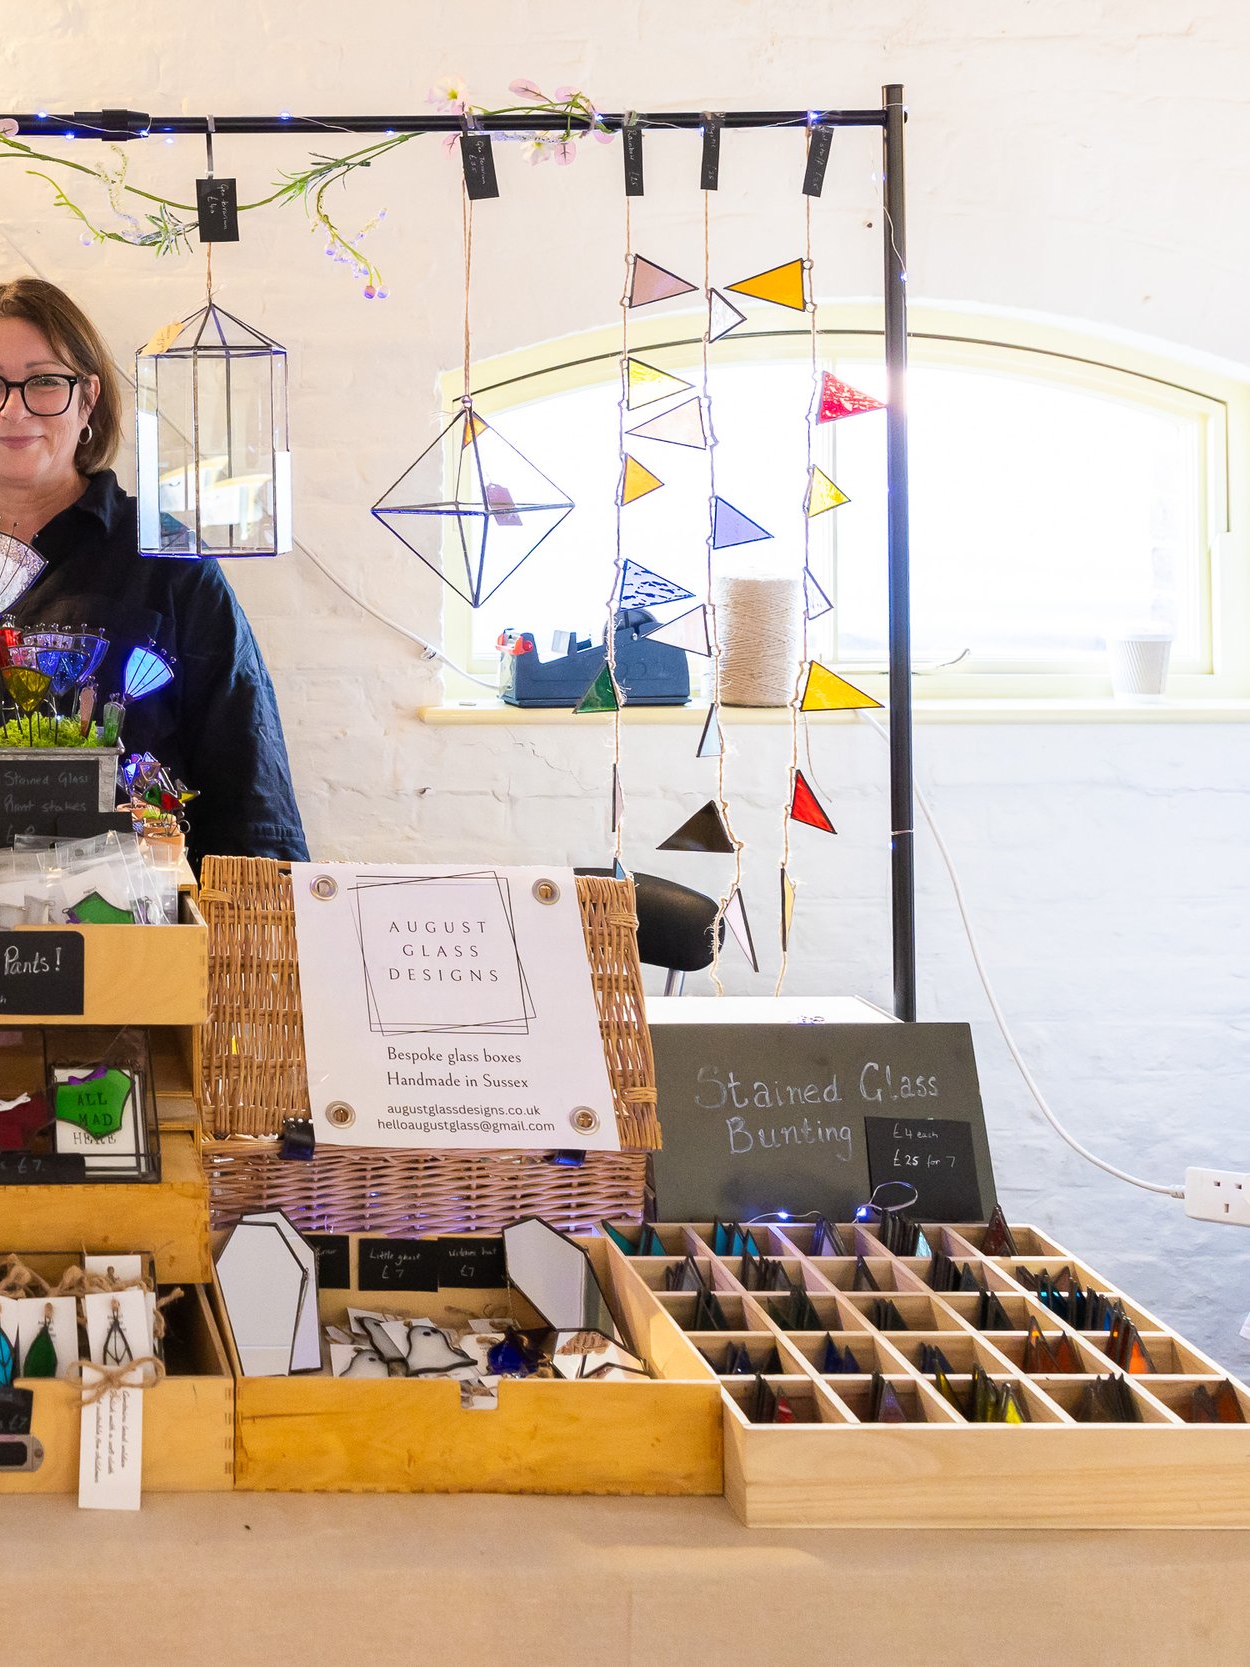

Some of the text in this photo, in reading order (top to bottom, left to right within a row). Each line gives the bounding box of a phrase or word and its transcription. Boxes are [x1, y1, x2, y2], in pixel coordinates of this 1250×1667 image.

[3, 770, 89, 788] Stained Glass
[4, 794, 87, 814] Plant stakes
[388, 920, 486, 934] AUGUST
[402, 944, 479, 958] GLASS
[4, 945, 62, 976] Pants!
[388, 967, 499, 982] DESIGNS
[387, 1046, 522, 1065] Bespoke glass boxes
[387, 1071, 529, 1088] Handmade in Sussex
[695, 1062, 940, 1110] Stained Glass
[77, 1092, 108, 1106] ALL
[387, 1104, 541, 1118] augustglassdesigns.co.uk
[79, 1113, 113, 1127] MAD
[377, 1119, 555, 1133] helloaugustglass@gmail.com
[73, 1131, 117, 1145] HERE
[726, 1116, 852, 1162] Bunting
[916, 1130, 939, 1139] each
[893, 1149, 956, 1168] £25 for 7
[370, 1248, 394, 1260] Little
[481, 1246, 497, 1256] hat
[460, 1264, 475, 1277] £7
